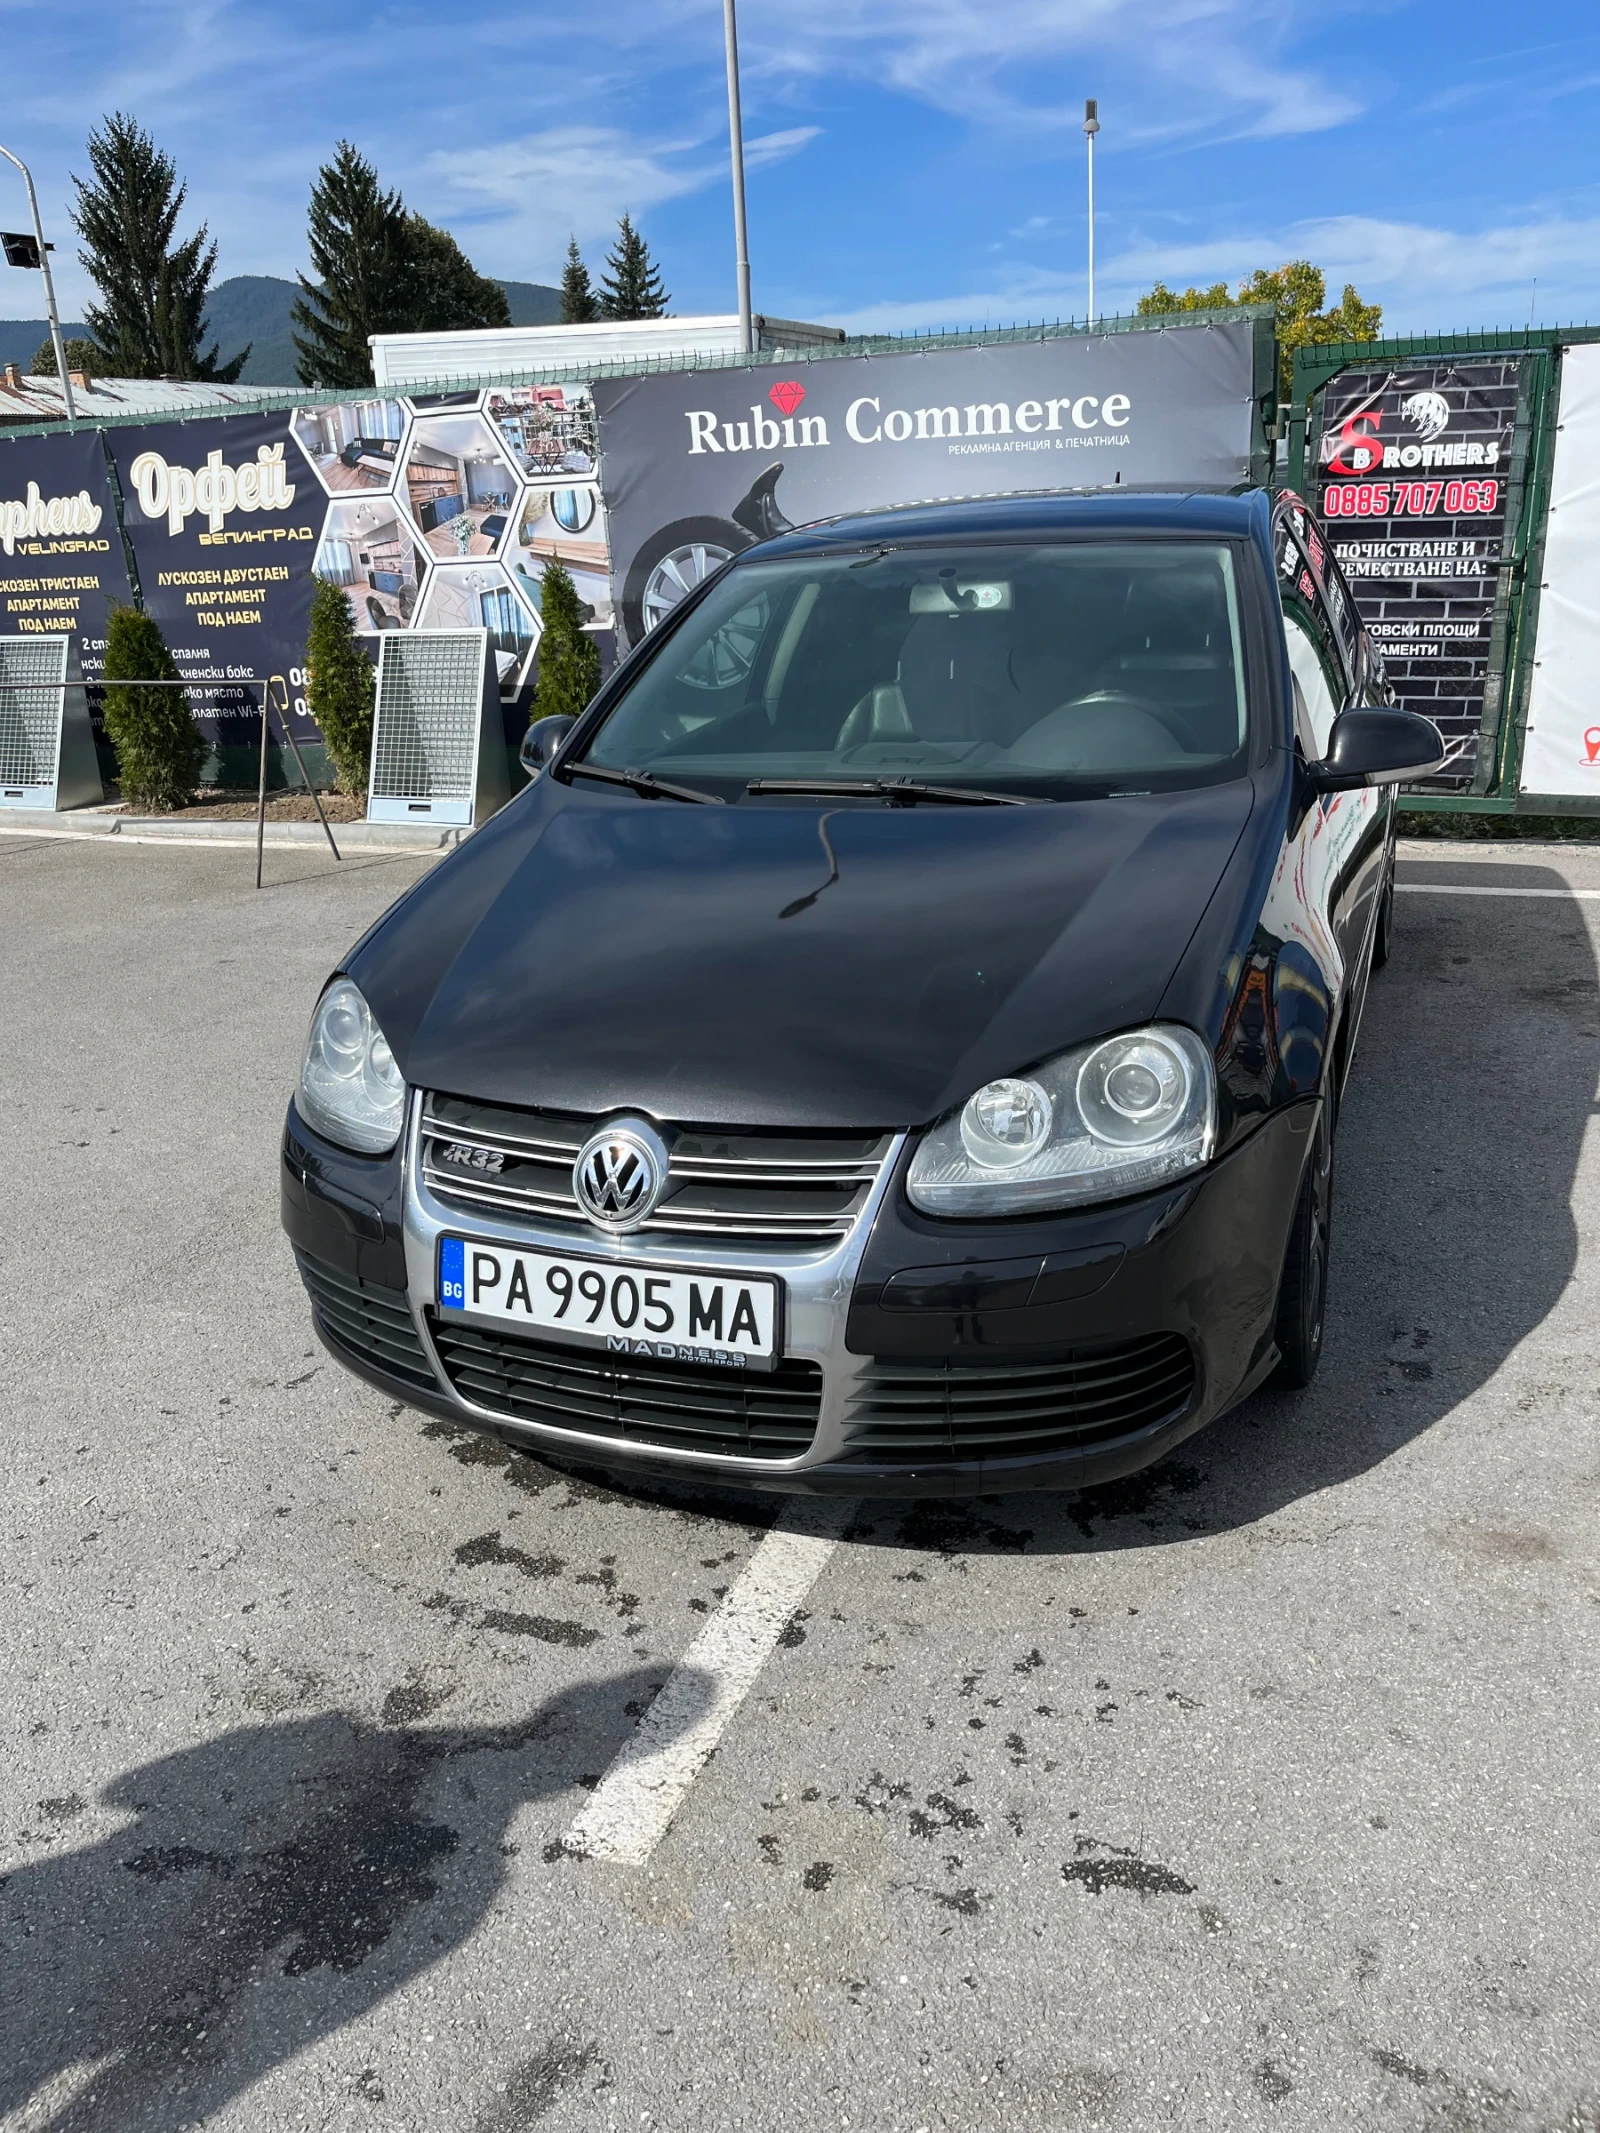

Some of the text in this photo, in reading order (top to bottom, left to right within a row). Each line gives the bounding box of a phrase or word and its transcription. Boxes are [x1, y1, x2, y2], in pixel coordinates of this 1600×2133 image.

[685, 393, 1131, 454] Rubin Commerce
[948, 434, 1131, 455] РЕКЛАМНА АГЕНЦИЯ & ПЕЧАТНИЦА
[130, 442, 296, 536] Орфей
[1323, 479, 1498, 517] 0885 707 063
[17, 539, 110, 556] VELINGRAD
[1335, 541, 1476, 558] ПОЧИСТВАНЕ И
[158, 566, 289, 586] ЛУСКОЗЕН ДВУСТАЕН
[1338, 560, 1487, 577] РЕМЕСТВАНЕ НА:
[40, 576, 100, 592] ТРИСТАЕН
[7, 597, 80, 612] АПАРТАМЕНТ
[185, 588, 267, 606] АПАРТАМЕНТ
[18, 617, 78, 632] ПОД НАЕМ
[197, 610, 262, 628] ПОД НАЕМ
[1423, 624, 1480, 638] ПЛОЩИ
[171, 648, 211, 659] спалня
[178, 665, 254, 679] хненски бокс
[205, 687, 244, 699] място
[191, 708, 237, 721] платен
[444, 1144, 505, 1174] R32
[443, 1280, 462, 1299] BG
[472, 1250, 761, 1346] PA 9905 MA
[606, 1334, 747, 1363] MADNESS
[678, 1354, 747, 1368] MOTORSPORT
